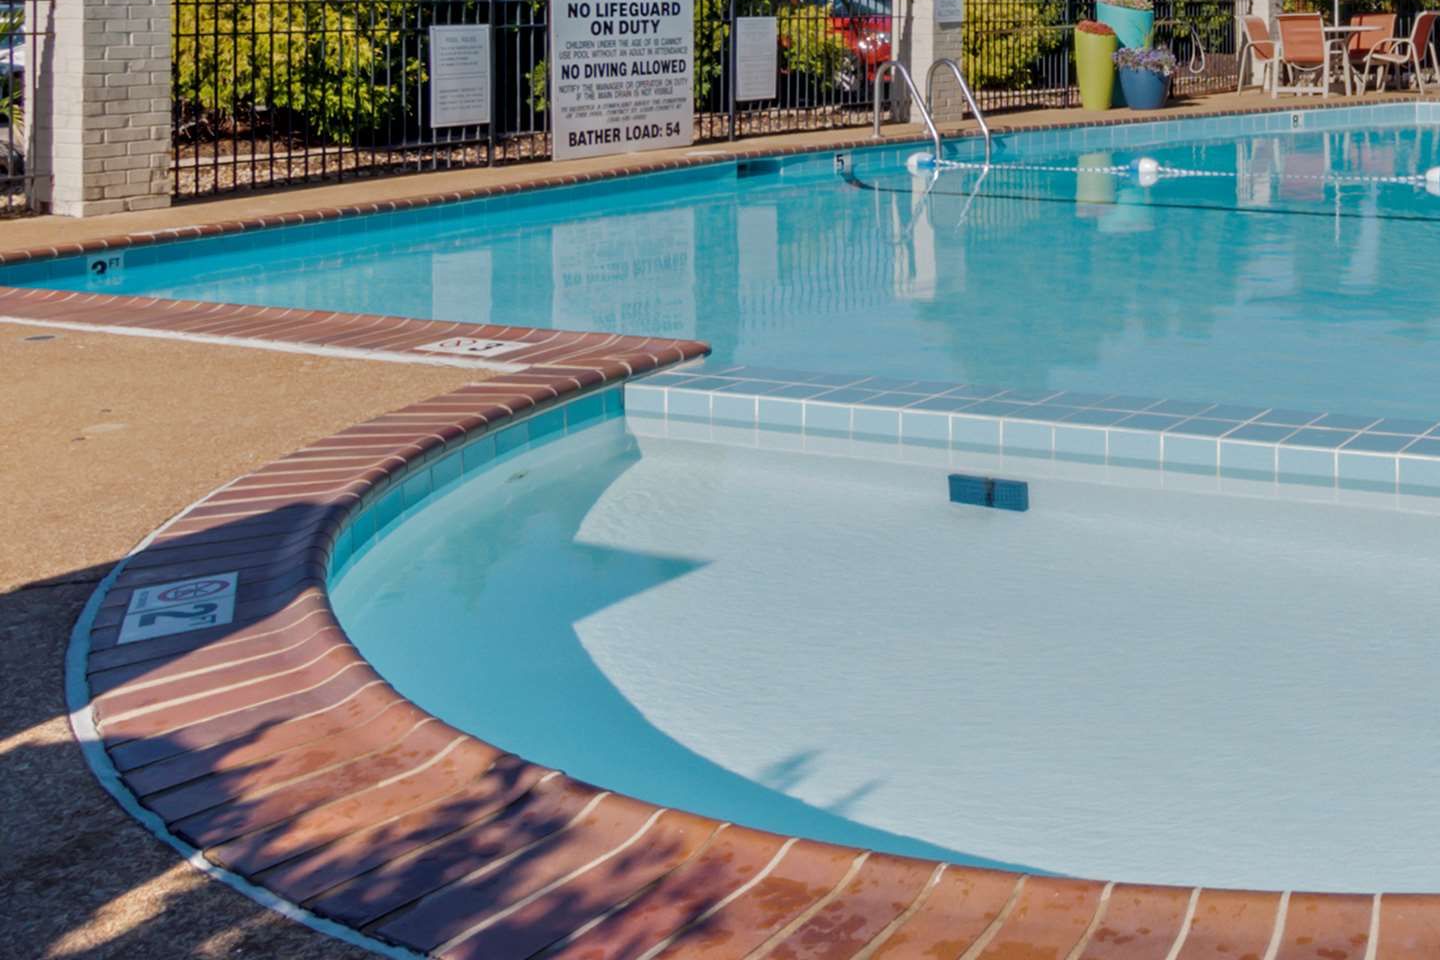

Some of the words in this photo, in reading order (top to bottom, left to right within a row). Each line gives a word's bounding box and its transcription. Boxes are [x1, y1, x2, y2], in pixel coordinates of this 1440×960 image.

[567, 2, 591, 18] NO
[595, 1, 681, 18] LIFEGUARD
[590, 20, 614, 36] ON
[618, 19, 661, 35] DUTY
[561, 64, 580, 80] NO
[584, 61, 627, 79] DIVING
[631, 59, 686, 76] ALLOWED
[568, 127, 621, 147] BATHER
[625, 124, 663, 141] LOAD:
[666, 121, 681, 137] 54
